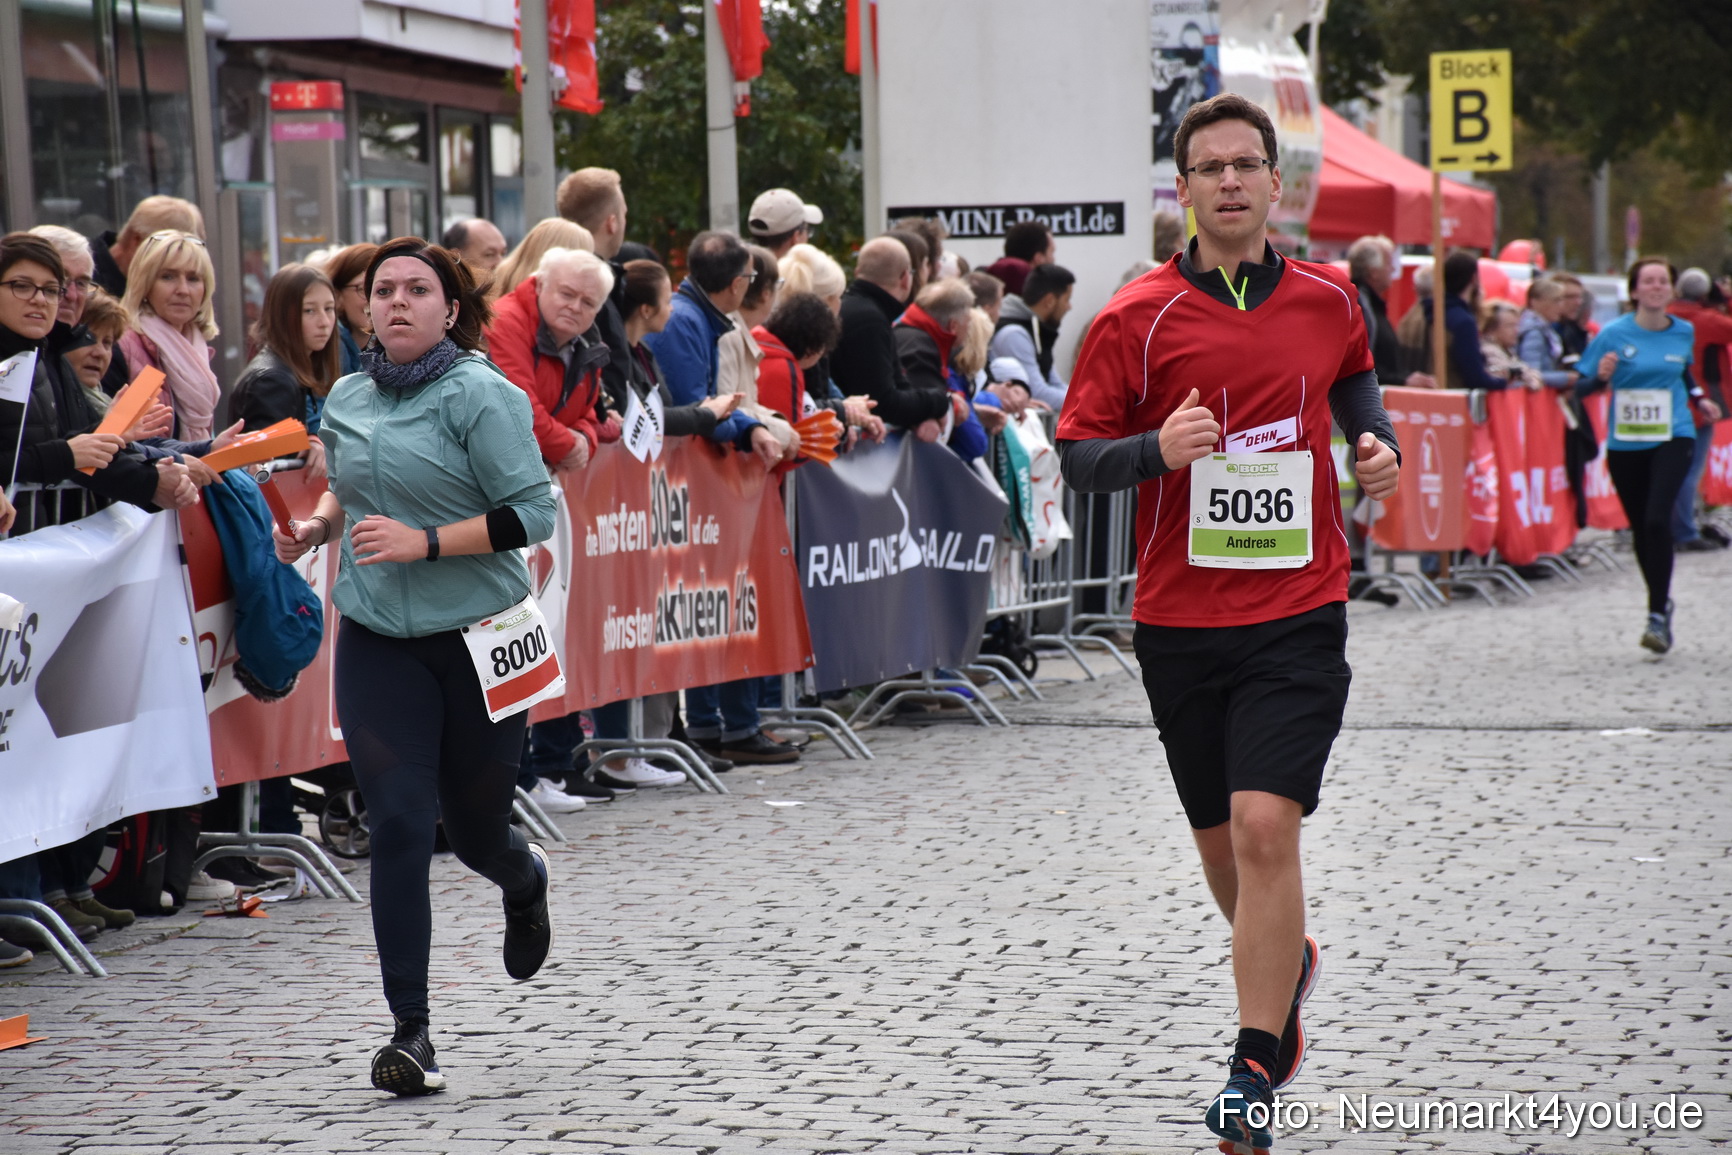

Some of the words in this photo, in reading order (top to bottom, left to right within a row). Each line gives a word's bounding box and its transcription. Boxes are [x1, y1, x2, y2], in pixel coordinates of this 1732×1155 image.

[1441, 58, 1501, 79] Block
[1453, 90, 1490, 143] B
[1622, 404, 1661, 421] 5131
[1245, 429, 1278, 447] DEHN
[1239, 462, 1279, 474] BOCK
[1208, 487, 1294, 524] 5036
[1226, 536, 1277, 549] Andreas
[808, 534, 898, 588] RAIL.ONE
[490, 624, 547, 678] 8000
